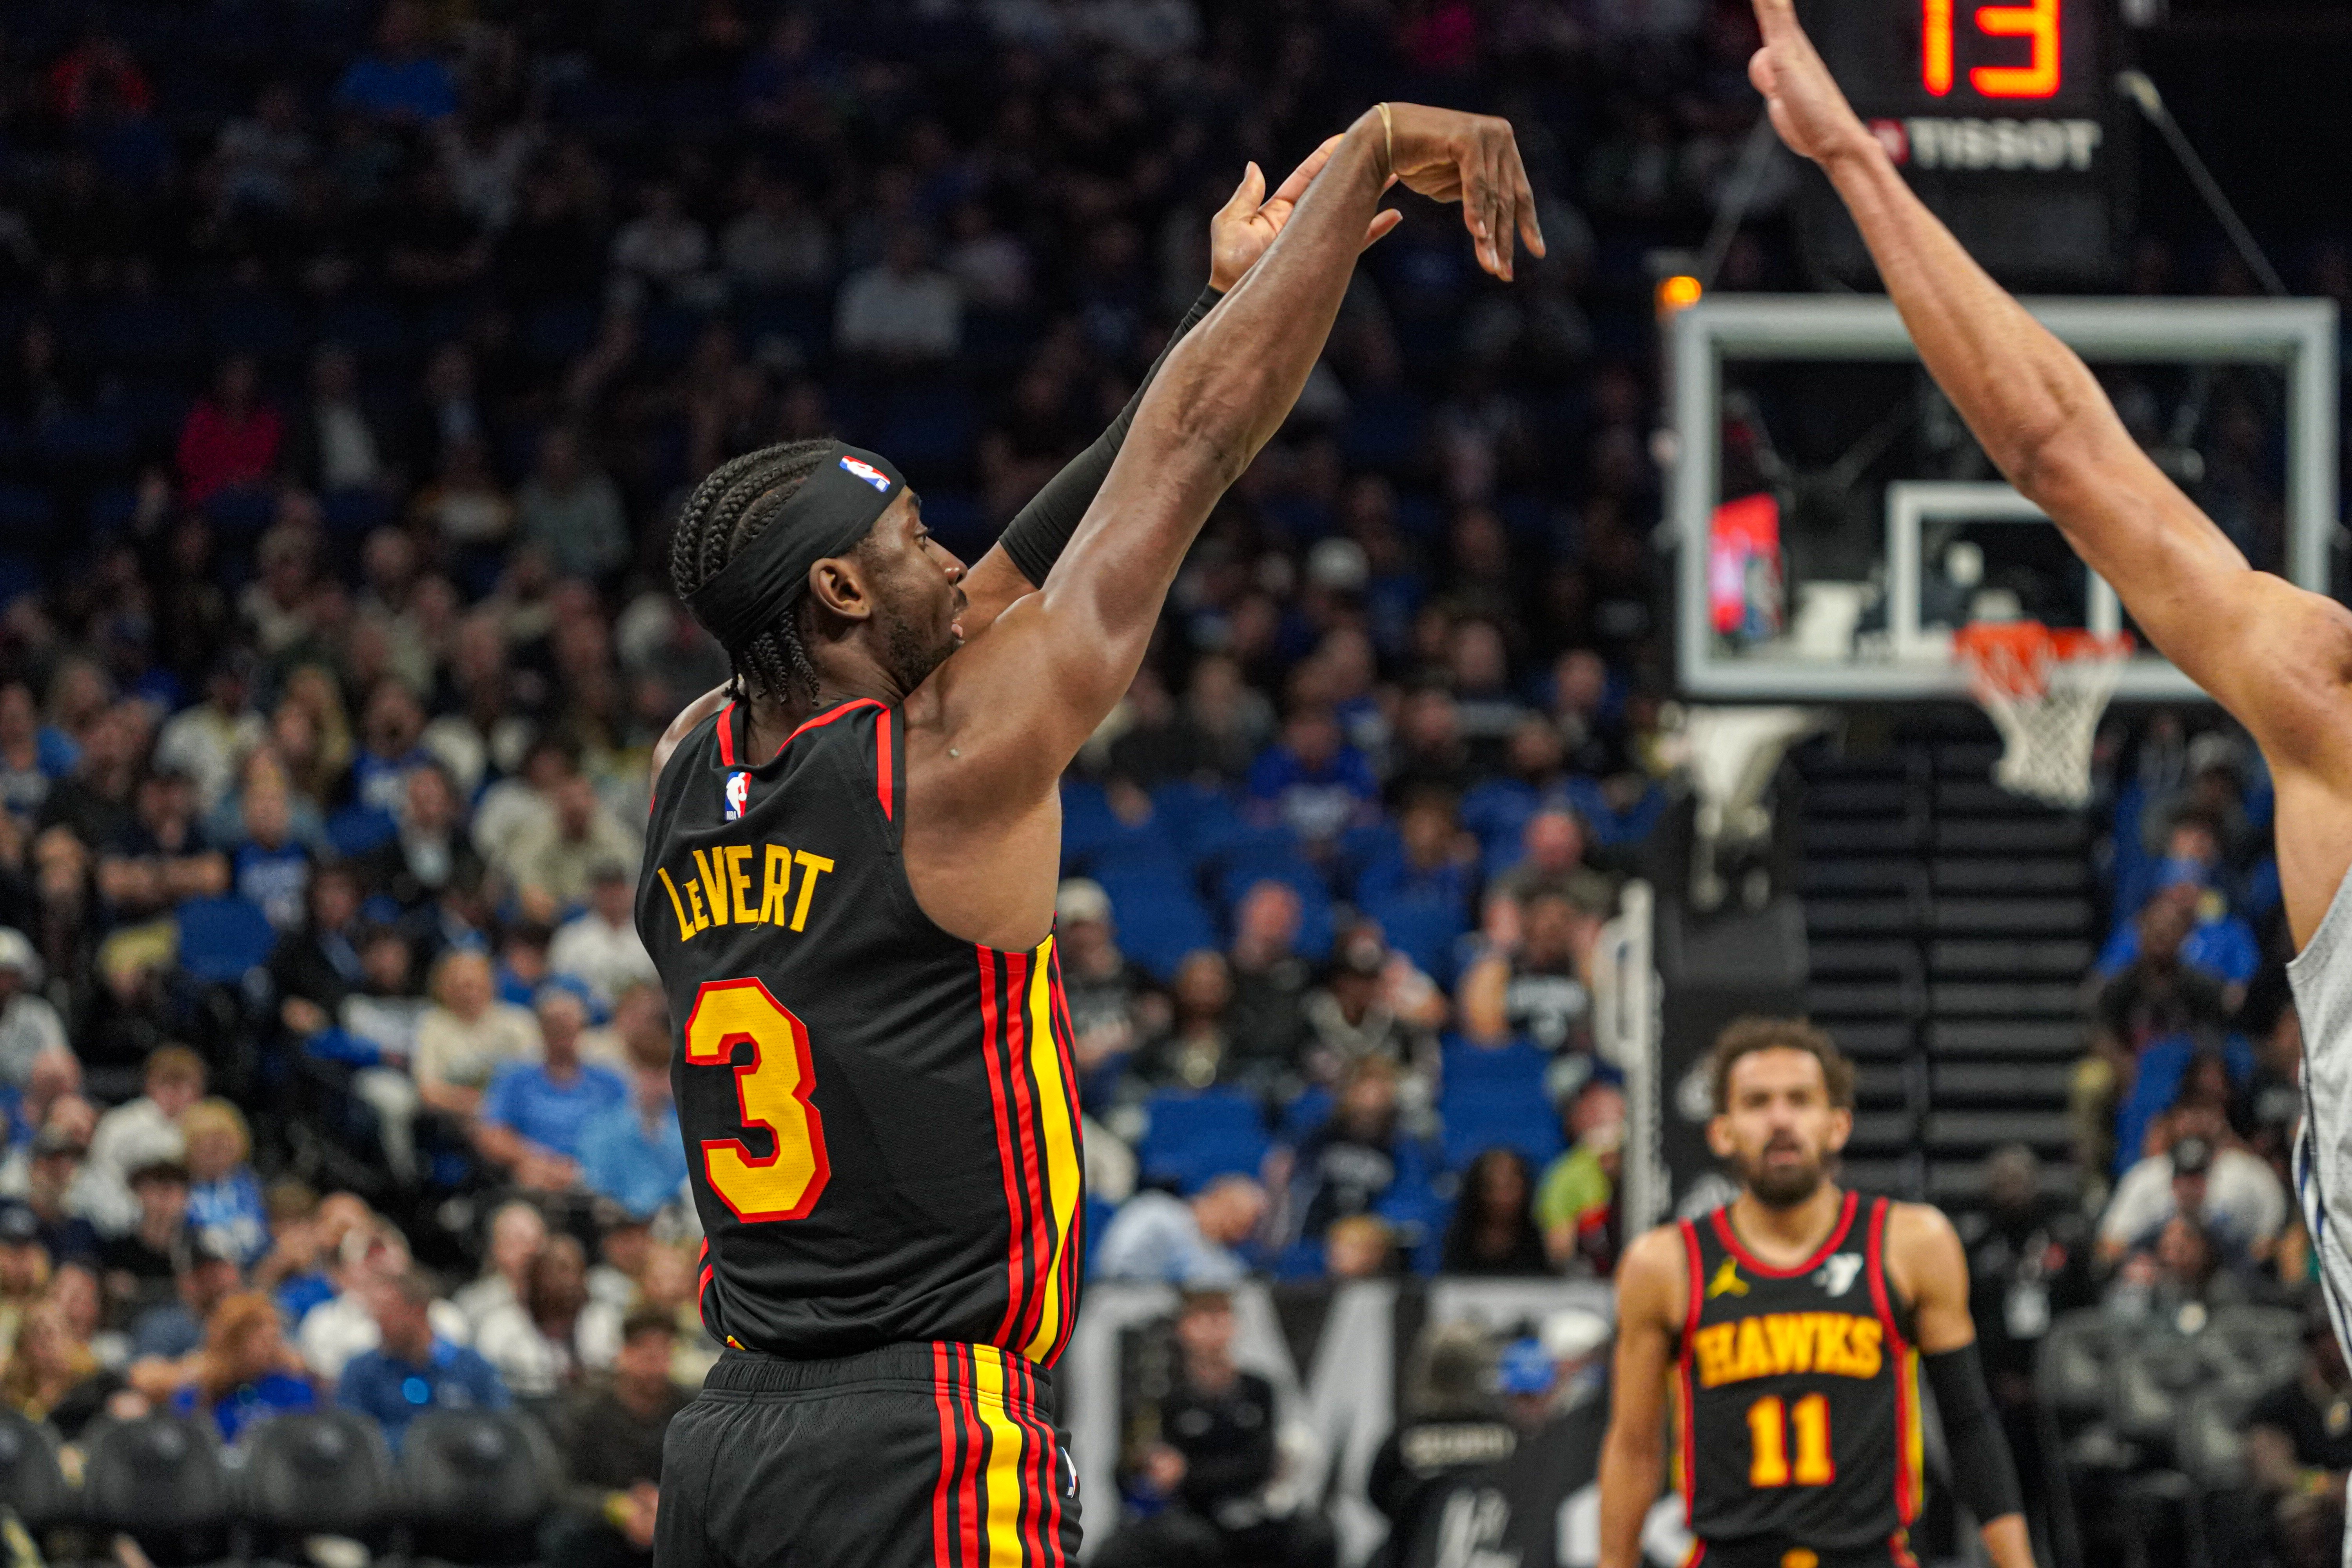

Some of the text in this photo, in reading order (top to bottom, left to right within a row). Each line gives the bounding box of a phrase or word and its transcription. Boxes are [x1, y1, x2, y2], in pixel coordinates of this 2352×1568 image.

[1907, 118, 2103, 170] TISSOT
[726, 811, 737, 820] NBA
[685, 976, 831, 1223] 3
[1694, 1312, 1882, 1388] HAWKS
[1746, 1393, 1835, 1487] 11
